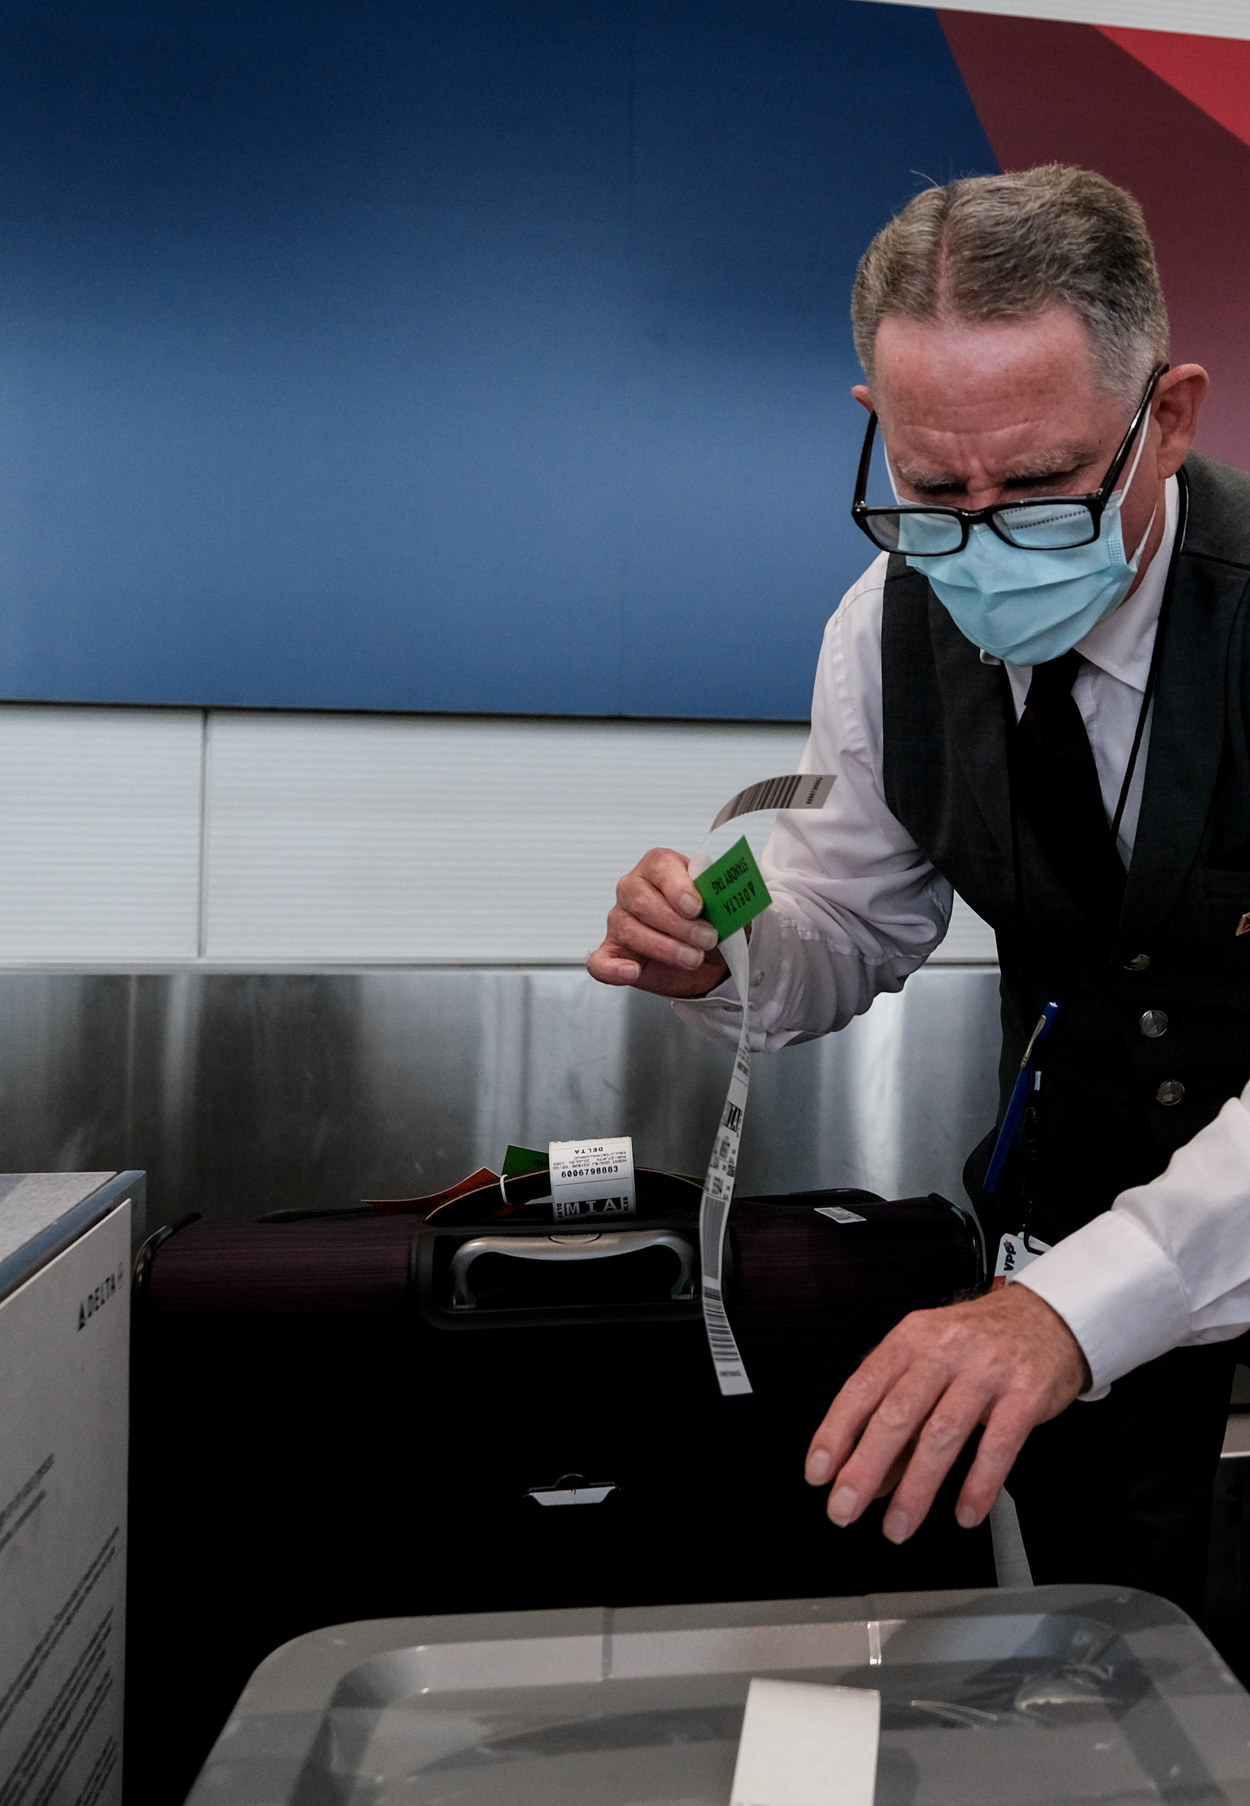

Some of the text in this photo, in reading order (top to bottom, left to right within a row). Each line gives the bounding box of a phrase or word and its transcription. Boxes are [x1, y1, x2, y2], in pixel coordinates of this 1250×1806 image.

[711, 877, 726, 895] TAG
[722, 888, 751, 915] DELTA
[565, 1198, 618, 1216] MIA
[87, 1272, 116, 1319] DELTA
